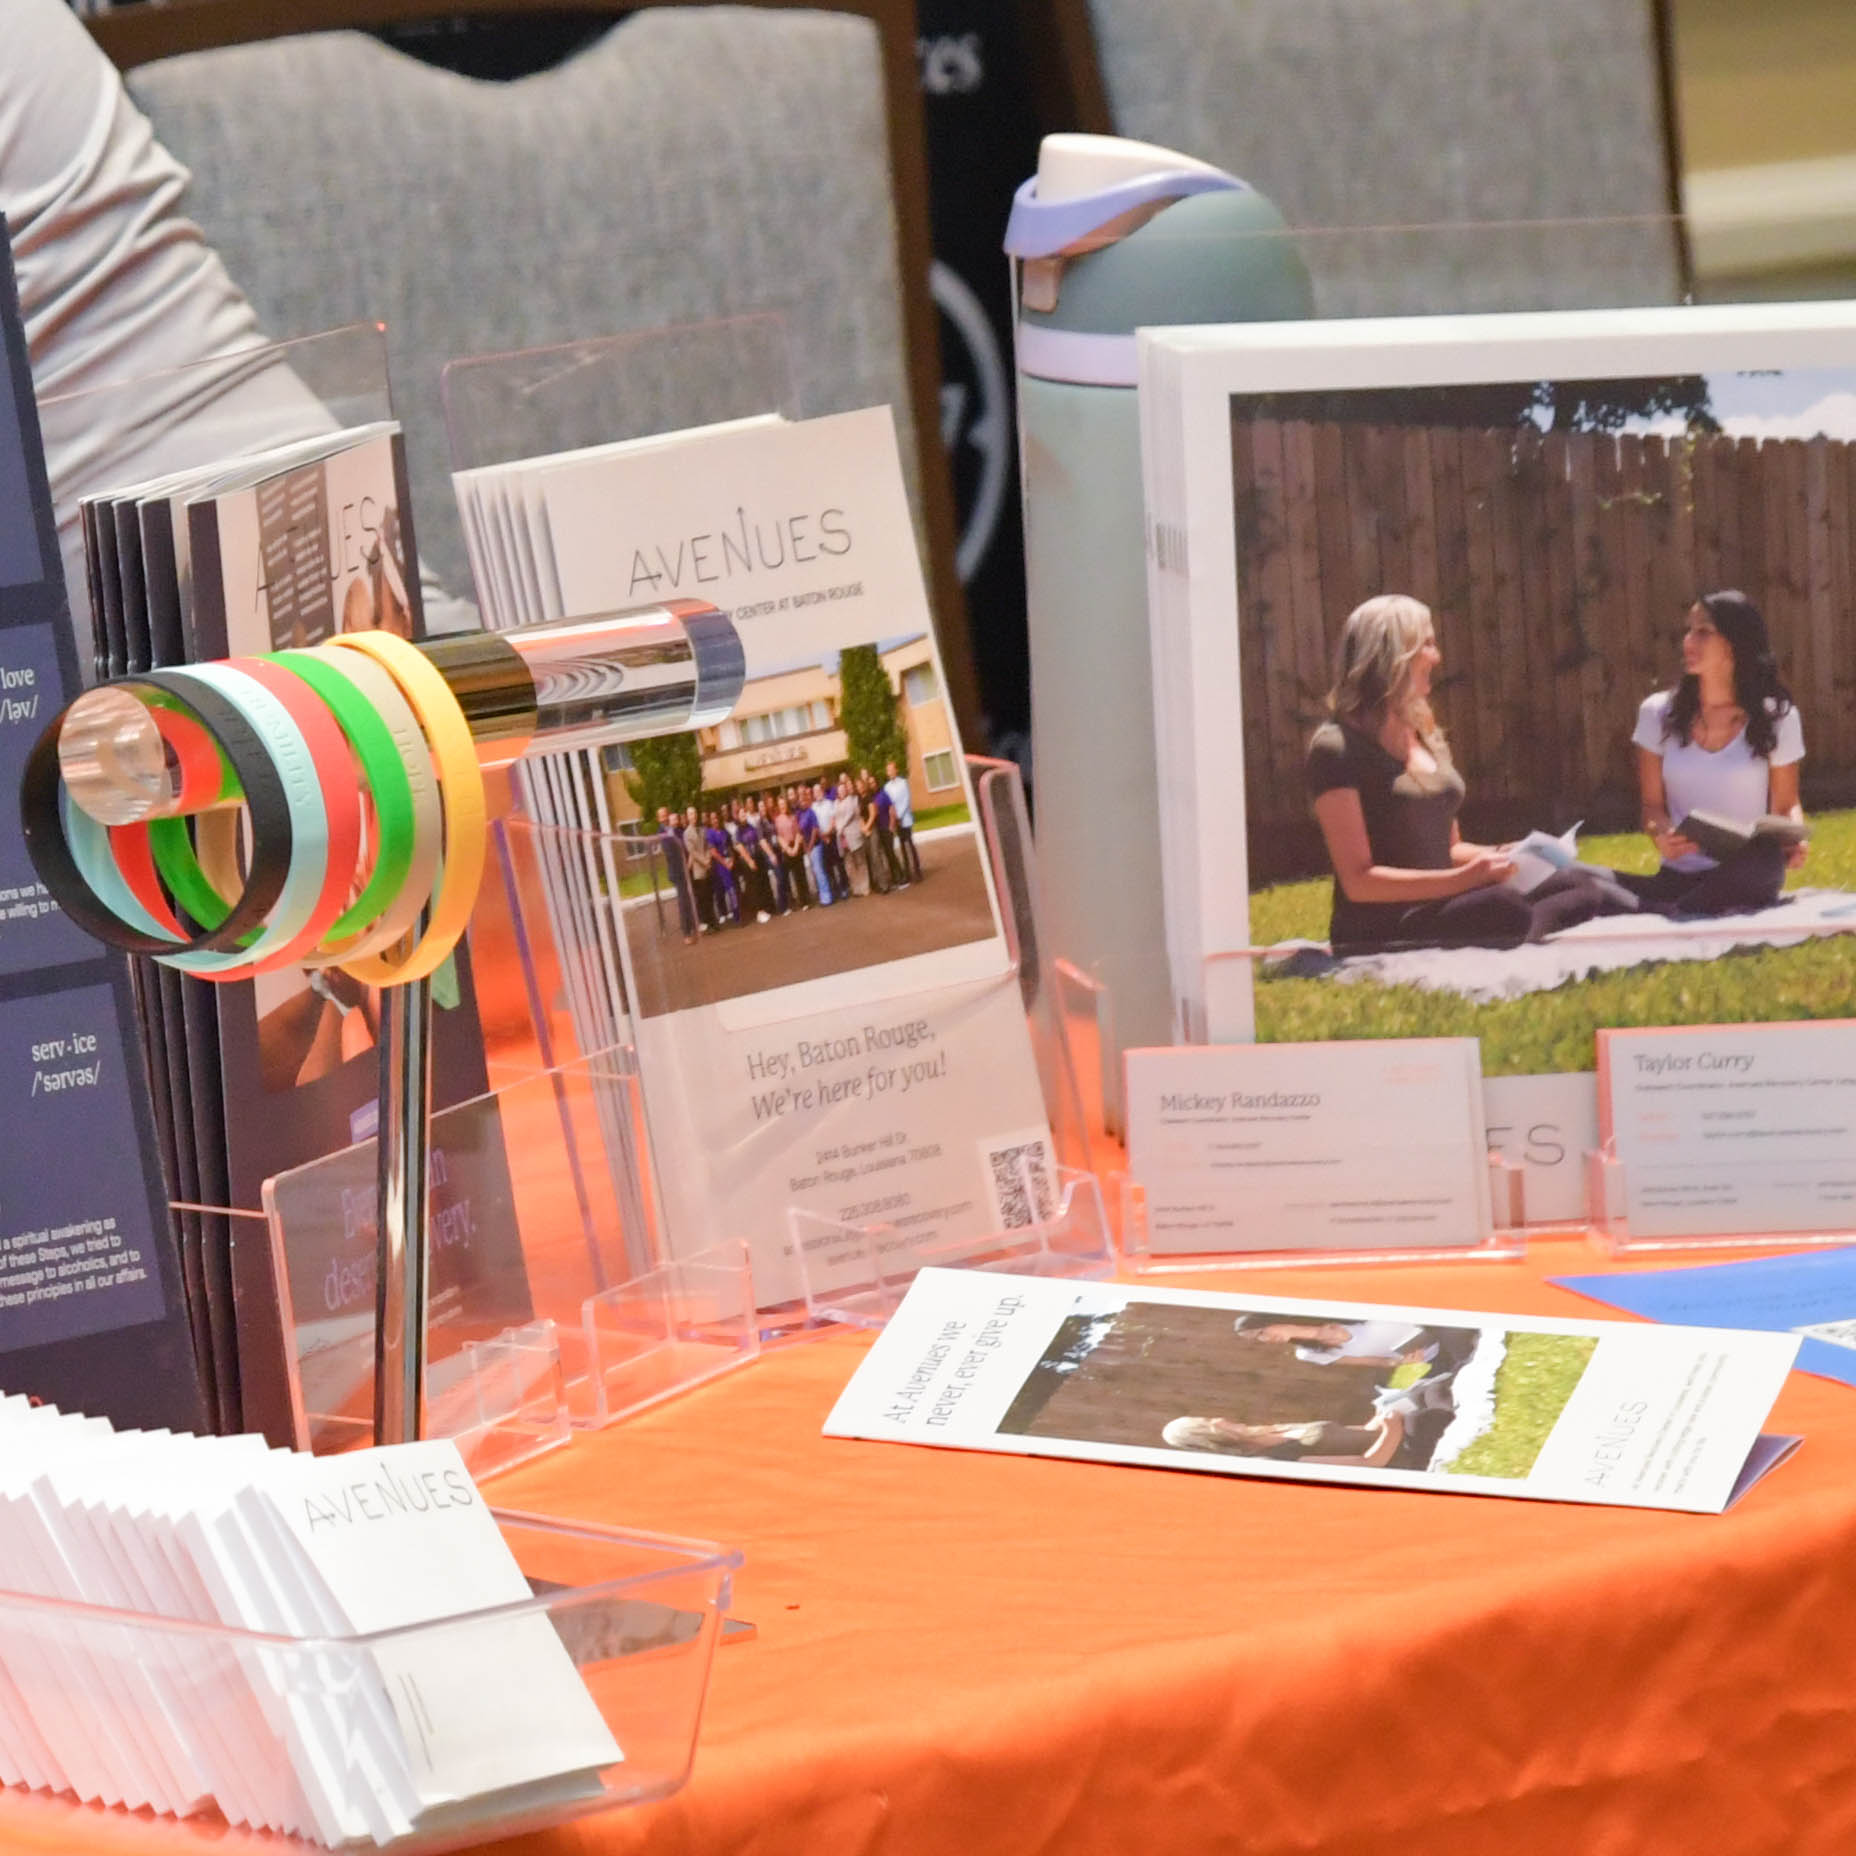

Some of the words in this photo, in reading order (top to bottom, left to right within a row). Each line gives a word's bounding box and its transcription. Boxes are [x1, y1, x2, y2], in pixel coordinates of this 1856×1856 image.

[628, 506, 852, 597] AVENUES
[0, 666, 36, 690] love
[746, 1051, 796, 1080] Hey,
[797, 1036, 861, 1068] Baton
[863, 1019, 936, 1053] Rouge,
[1633, 1052, 1692, 1075] Taylor
[1696, 1052, 1755, 1073] Curry
[751, 1087, 814, 1120] We're
[817, 1077, 862, 1107] here
[866, 1066, 896, 1101] for
[901, 1049, 948, 1093] you!
[1160, 1092, 1225, 1114] Mickey
[1230, 1092, 1322, 1110] Randazzo
[896, 1343, 952, 1403] Avenues
[1584, 1400, 1649, 1489] AVENUES
[304, 1462, 474, 1533] AVENUES
